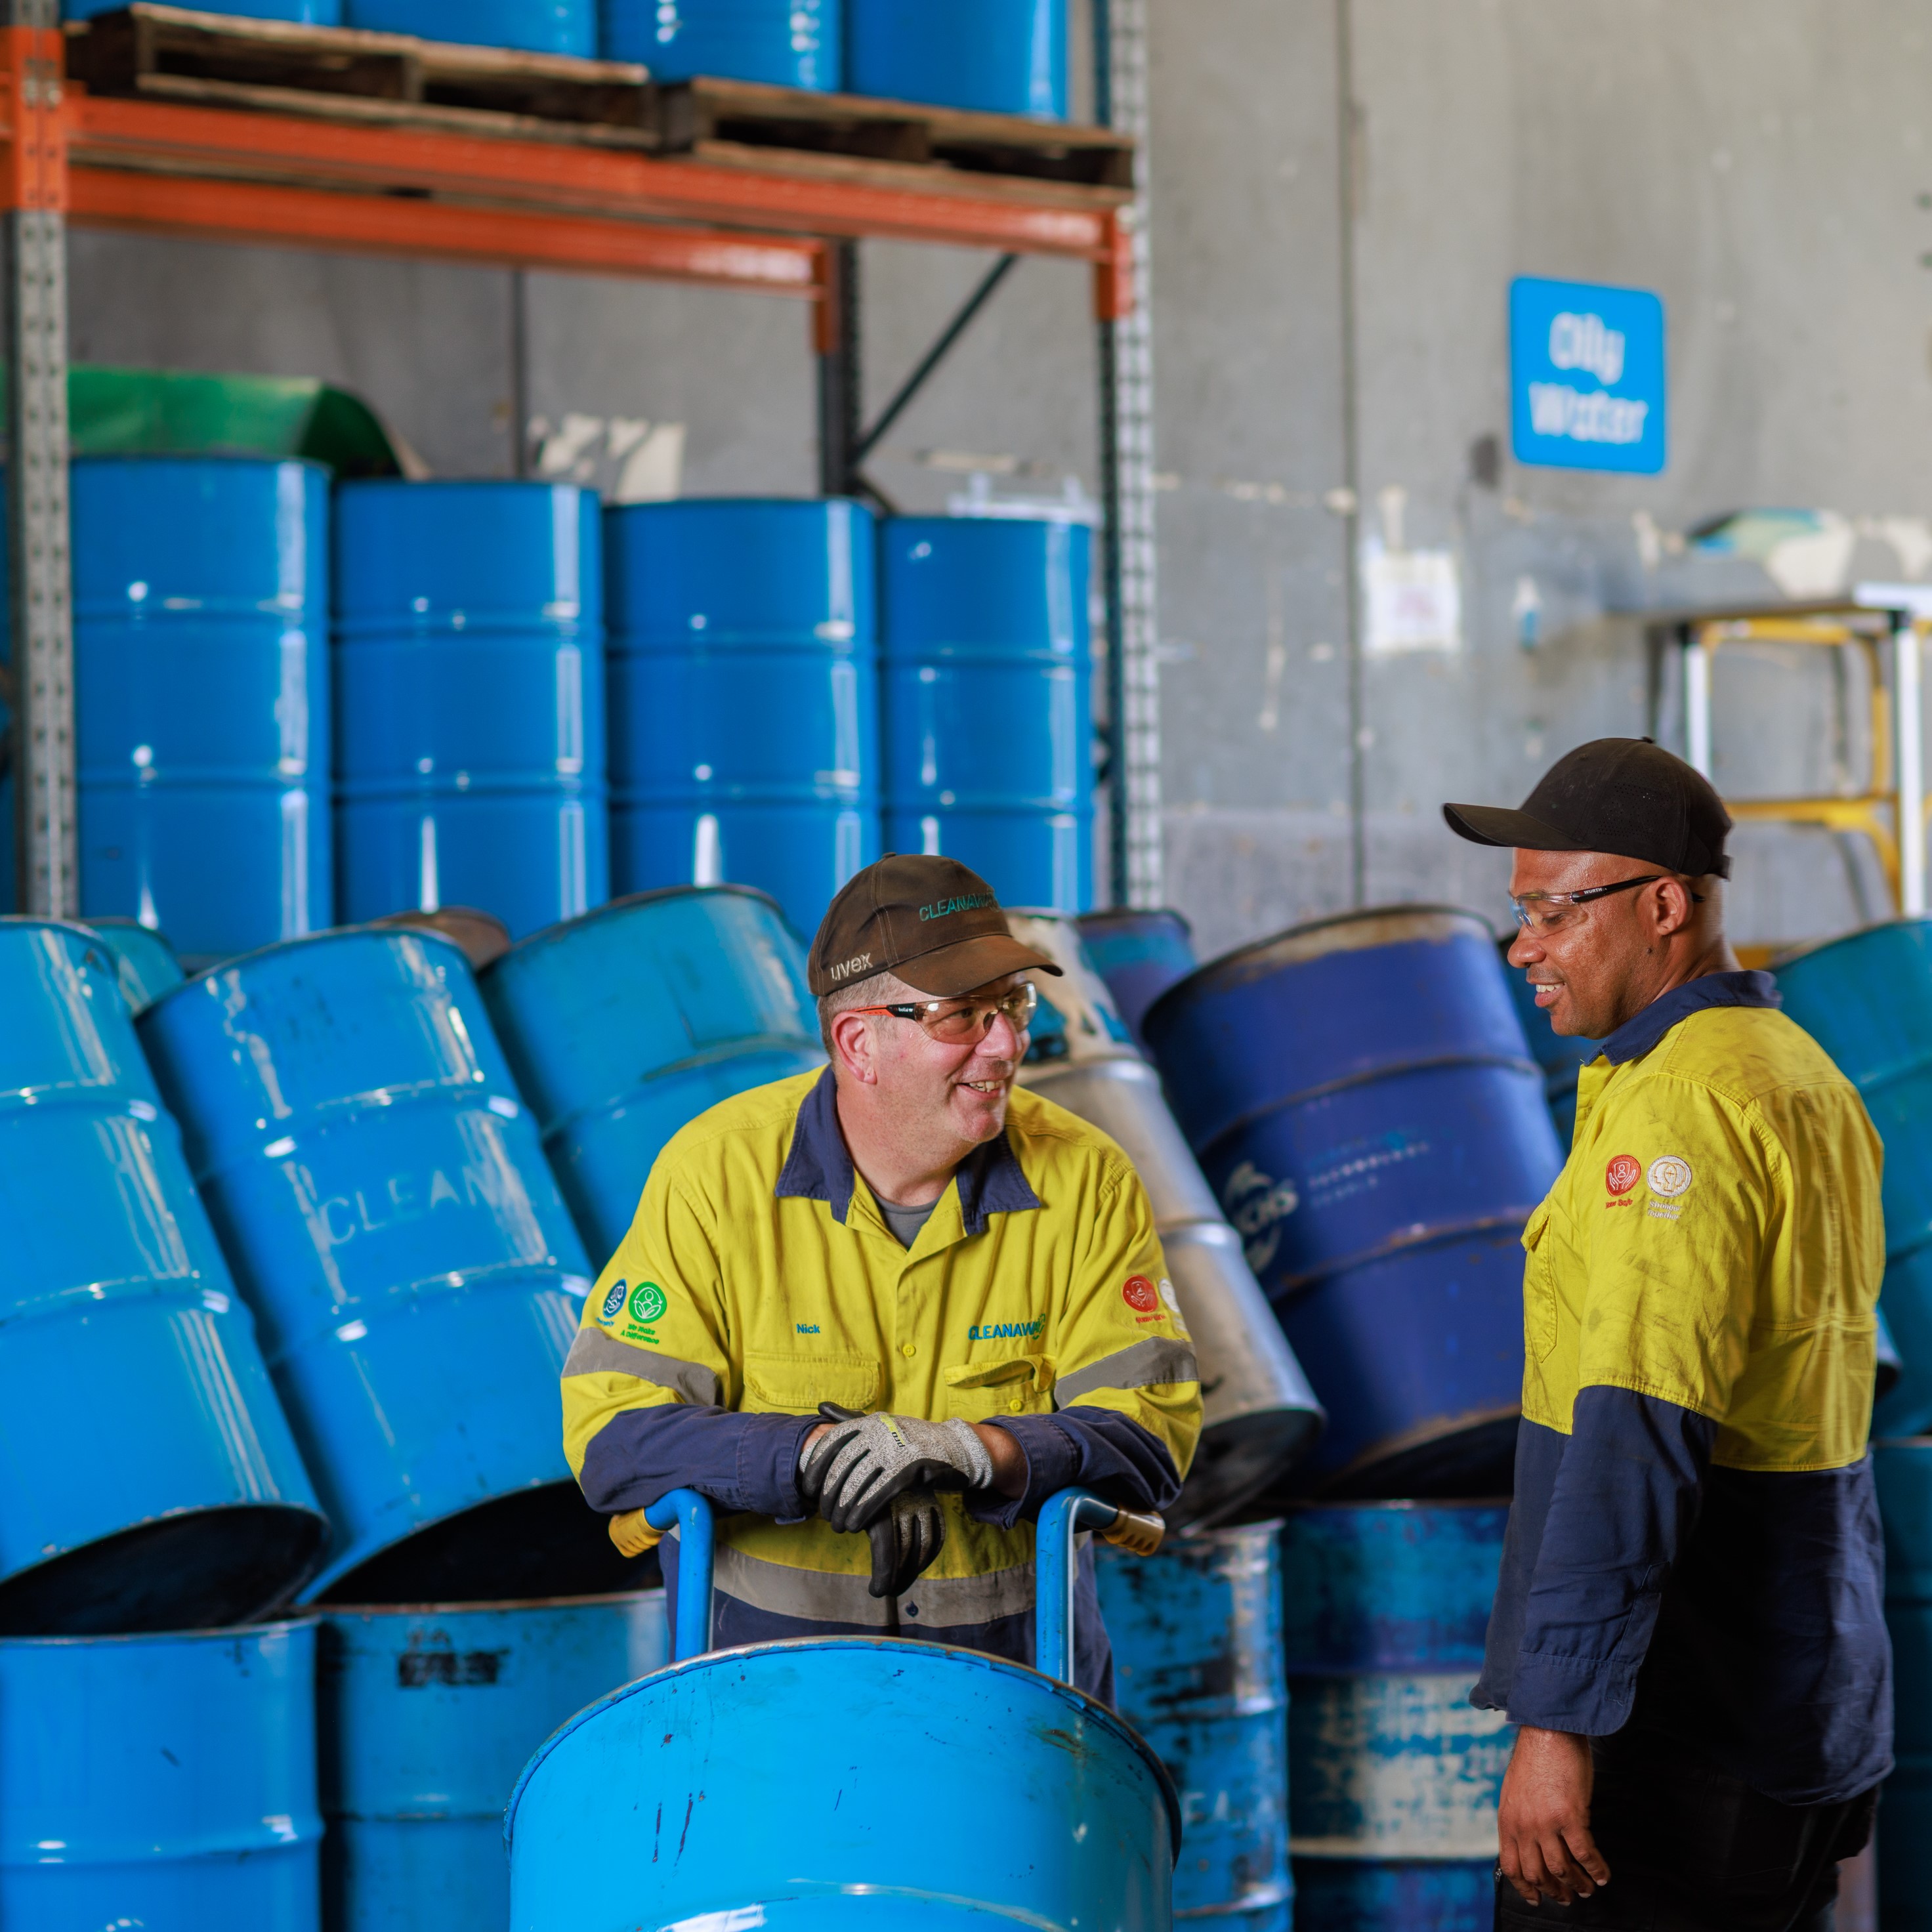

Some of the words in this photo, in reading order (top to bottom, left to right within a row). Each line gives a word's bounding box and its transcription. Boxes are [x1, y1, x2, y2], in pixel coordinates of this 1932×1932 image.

[1528, 380, 1650, 445] Water
[919, 892, 994, 922] CLEANAWA
[830, 952, 873, 981] uvex
[1648, 1208, 1680, 1219] Together
[1649, 1199, 1681, 1211] Stronger
[796, 1323, 820, 1334] Nick
[968, 1320, 1041, 1340] CLEANAWA
